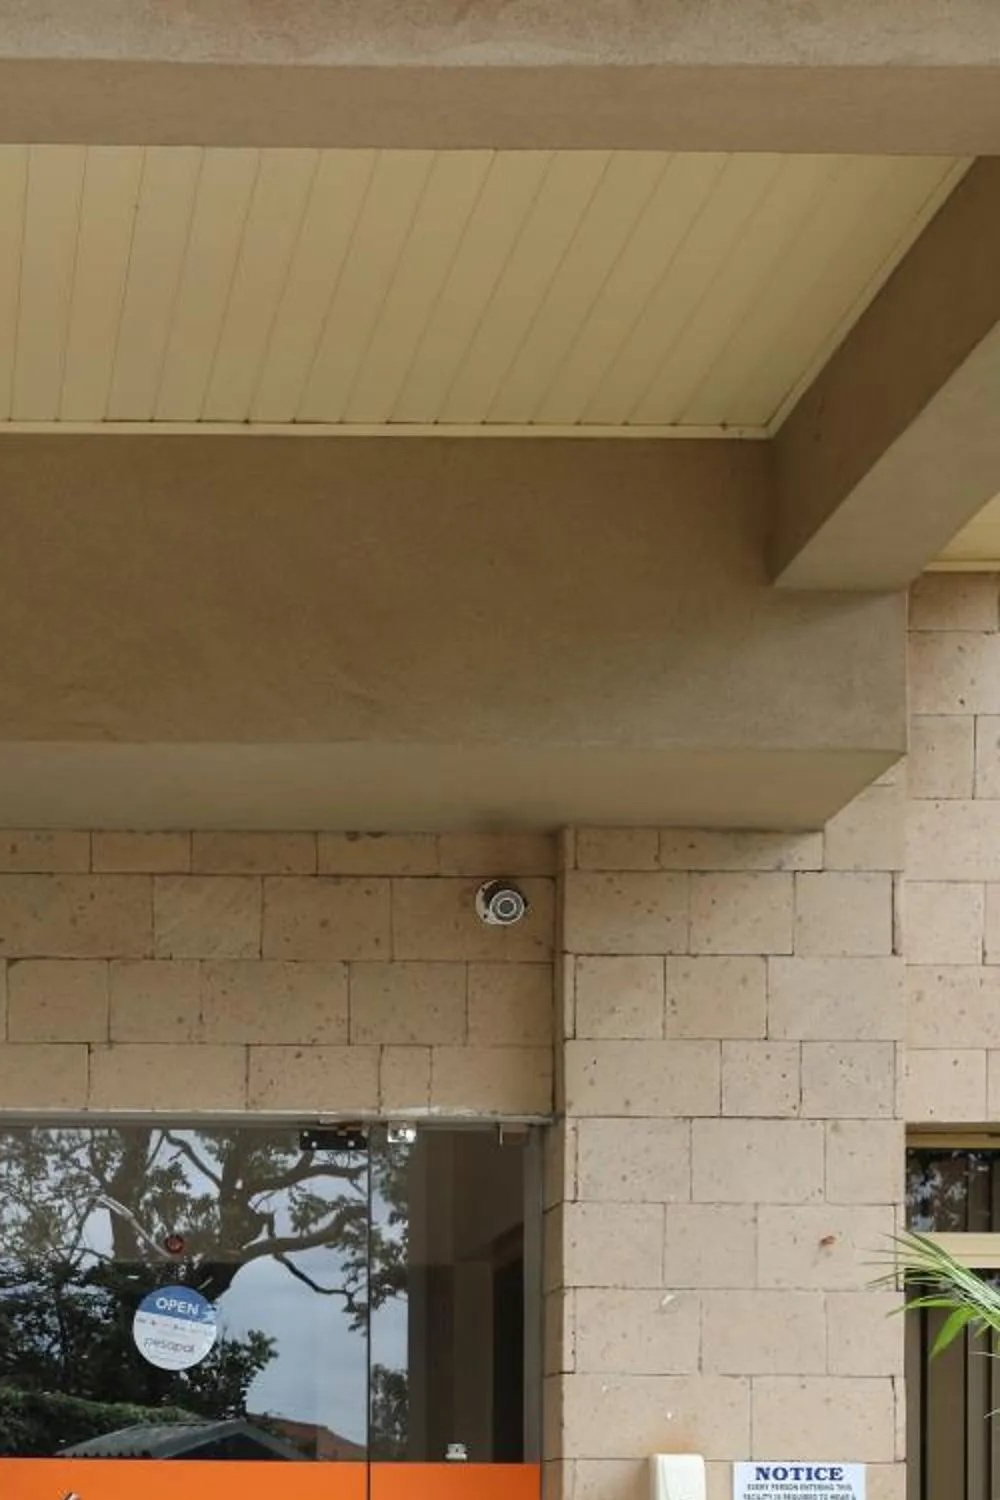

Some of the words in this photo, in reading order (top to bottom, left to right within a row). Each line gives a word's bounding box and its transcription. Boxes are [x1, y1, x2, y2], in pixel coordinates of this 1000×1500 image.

[156, 1296, 200, 1315] OPEN
[755, 1467, 844, 1481] NOTICE
[783, 1493, 817, 1500] REQUIRED
